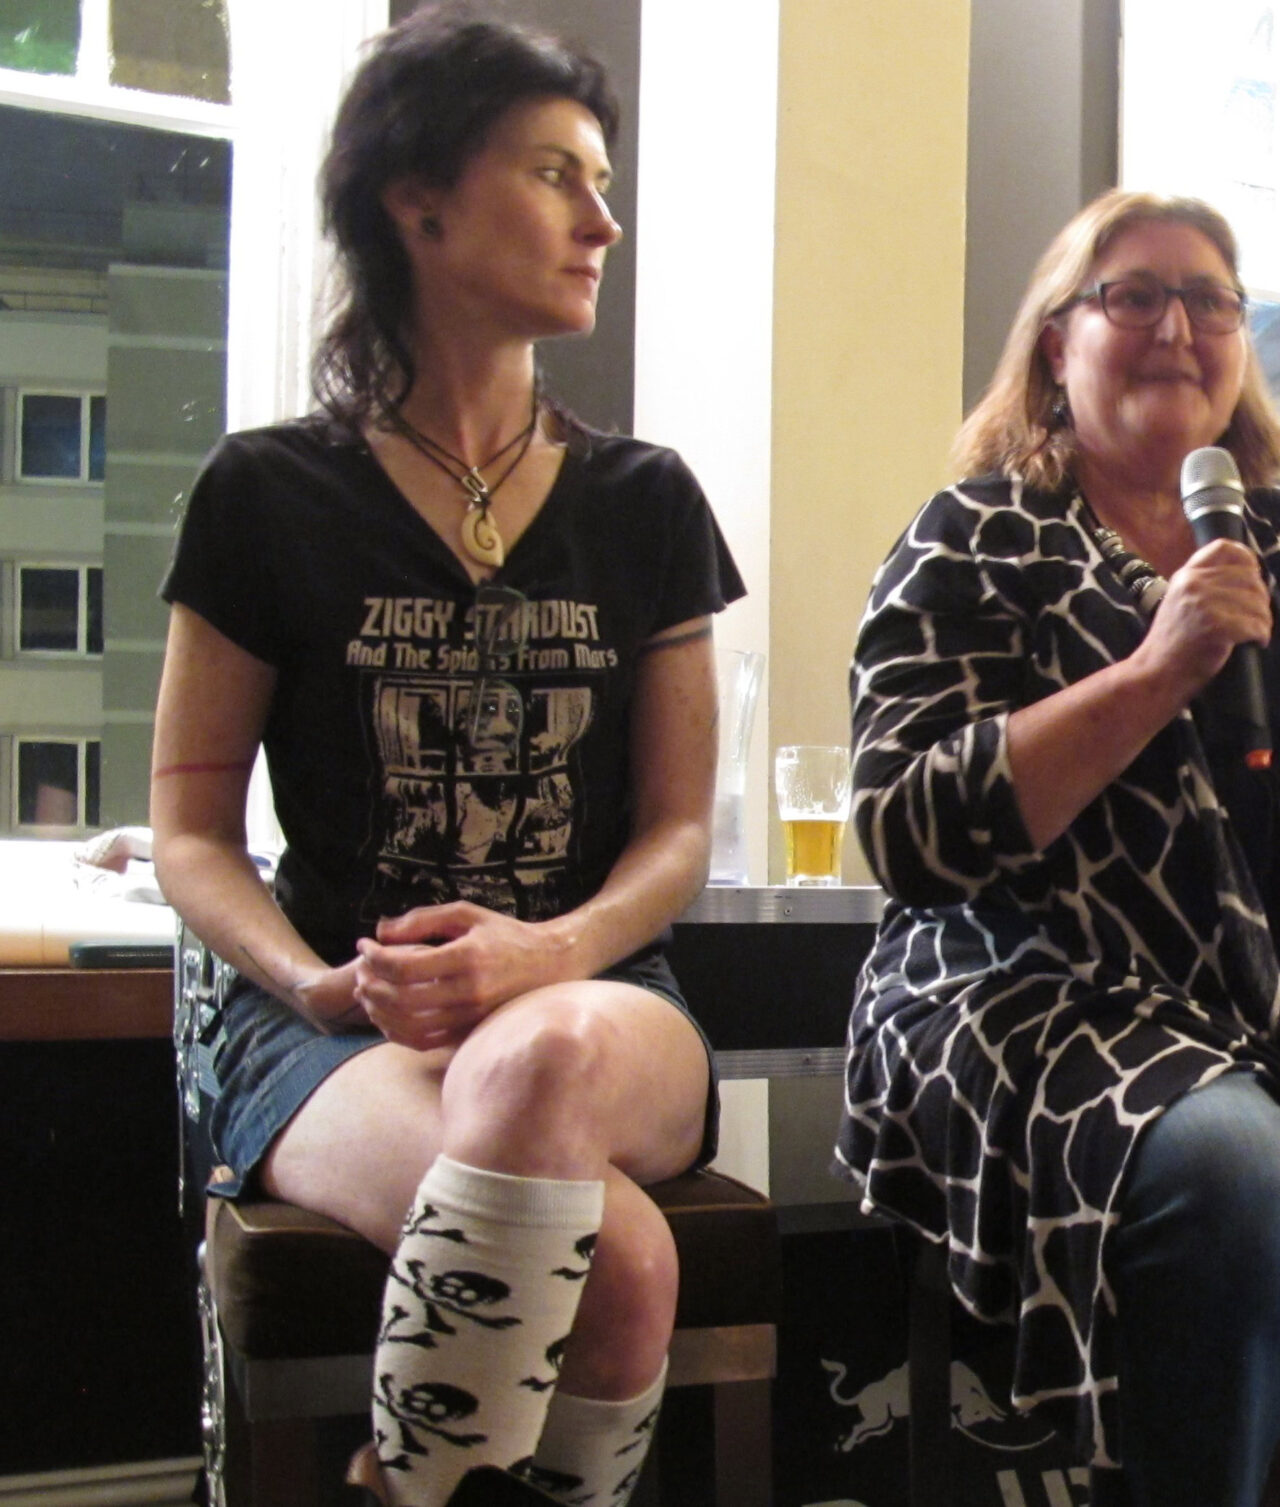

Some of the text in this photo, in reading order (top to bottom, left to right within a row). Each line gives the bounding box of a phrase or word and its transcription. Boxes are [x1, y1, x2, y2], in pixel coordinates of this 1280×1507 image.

[360, 597, 455, 639] ZIGGY
[346, 639, 386, 668] And
[393, 641, 430, 669] The
[517, 645, 569, 669] From
[575, 643, 618, 669] Mars
